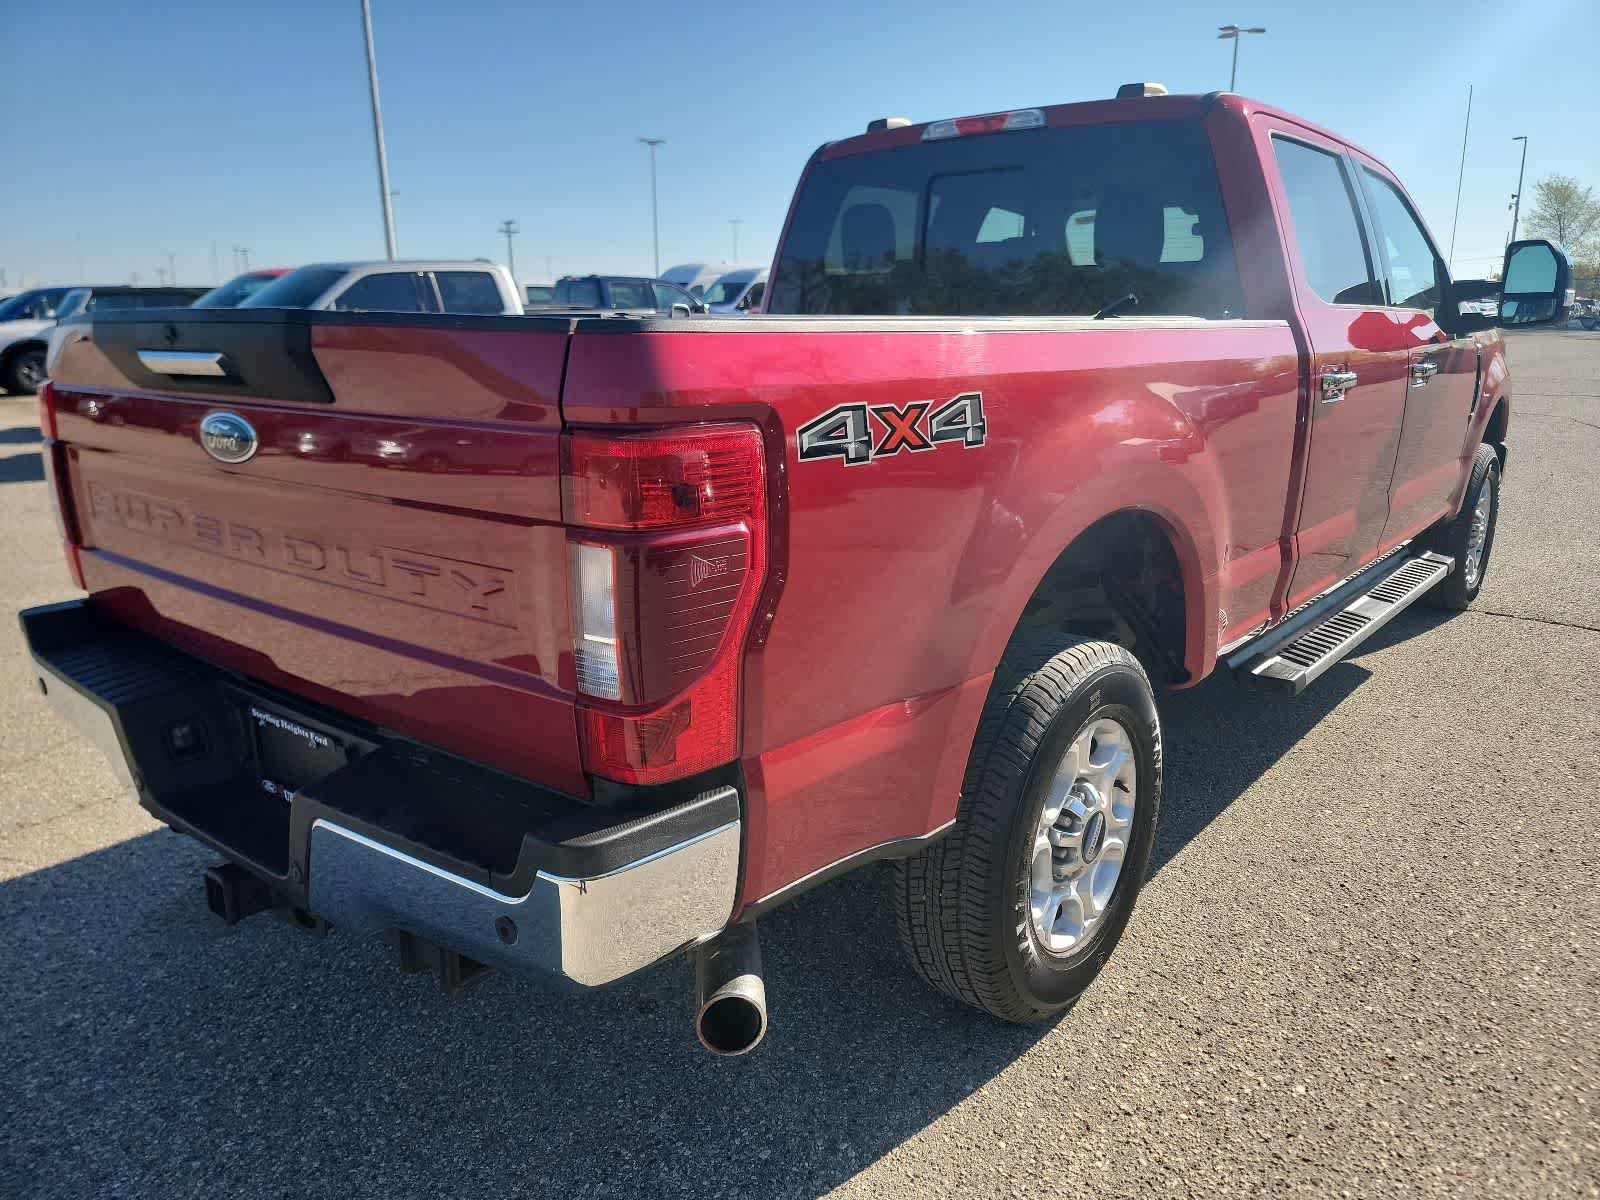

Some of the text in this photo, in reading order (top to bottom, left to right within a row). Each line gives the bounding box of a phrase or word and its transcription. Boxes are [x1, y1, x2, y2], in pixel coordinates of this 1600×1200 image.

[207, 421, 240, 451] Ford
[89, 479, 506, 611] SUPER DUTY
[280, 719, 309, 737] Heights
[309, 732, 328, 746] Ford
